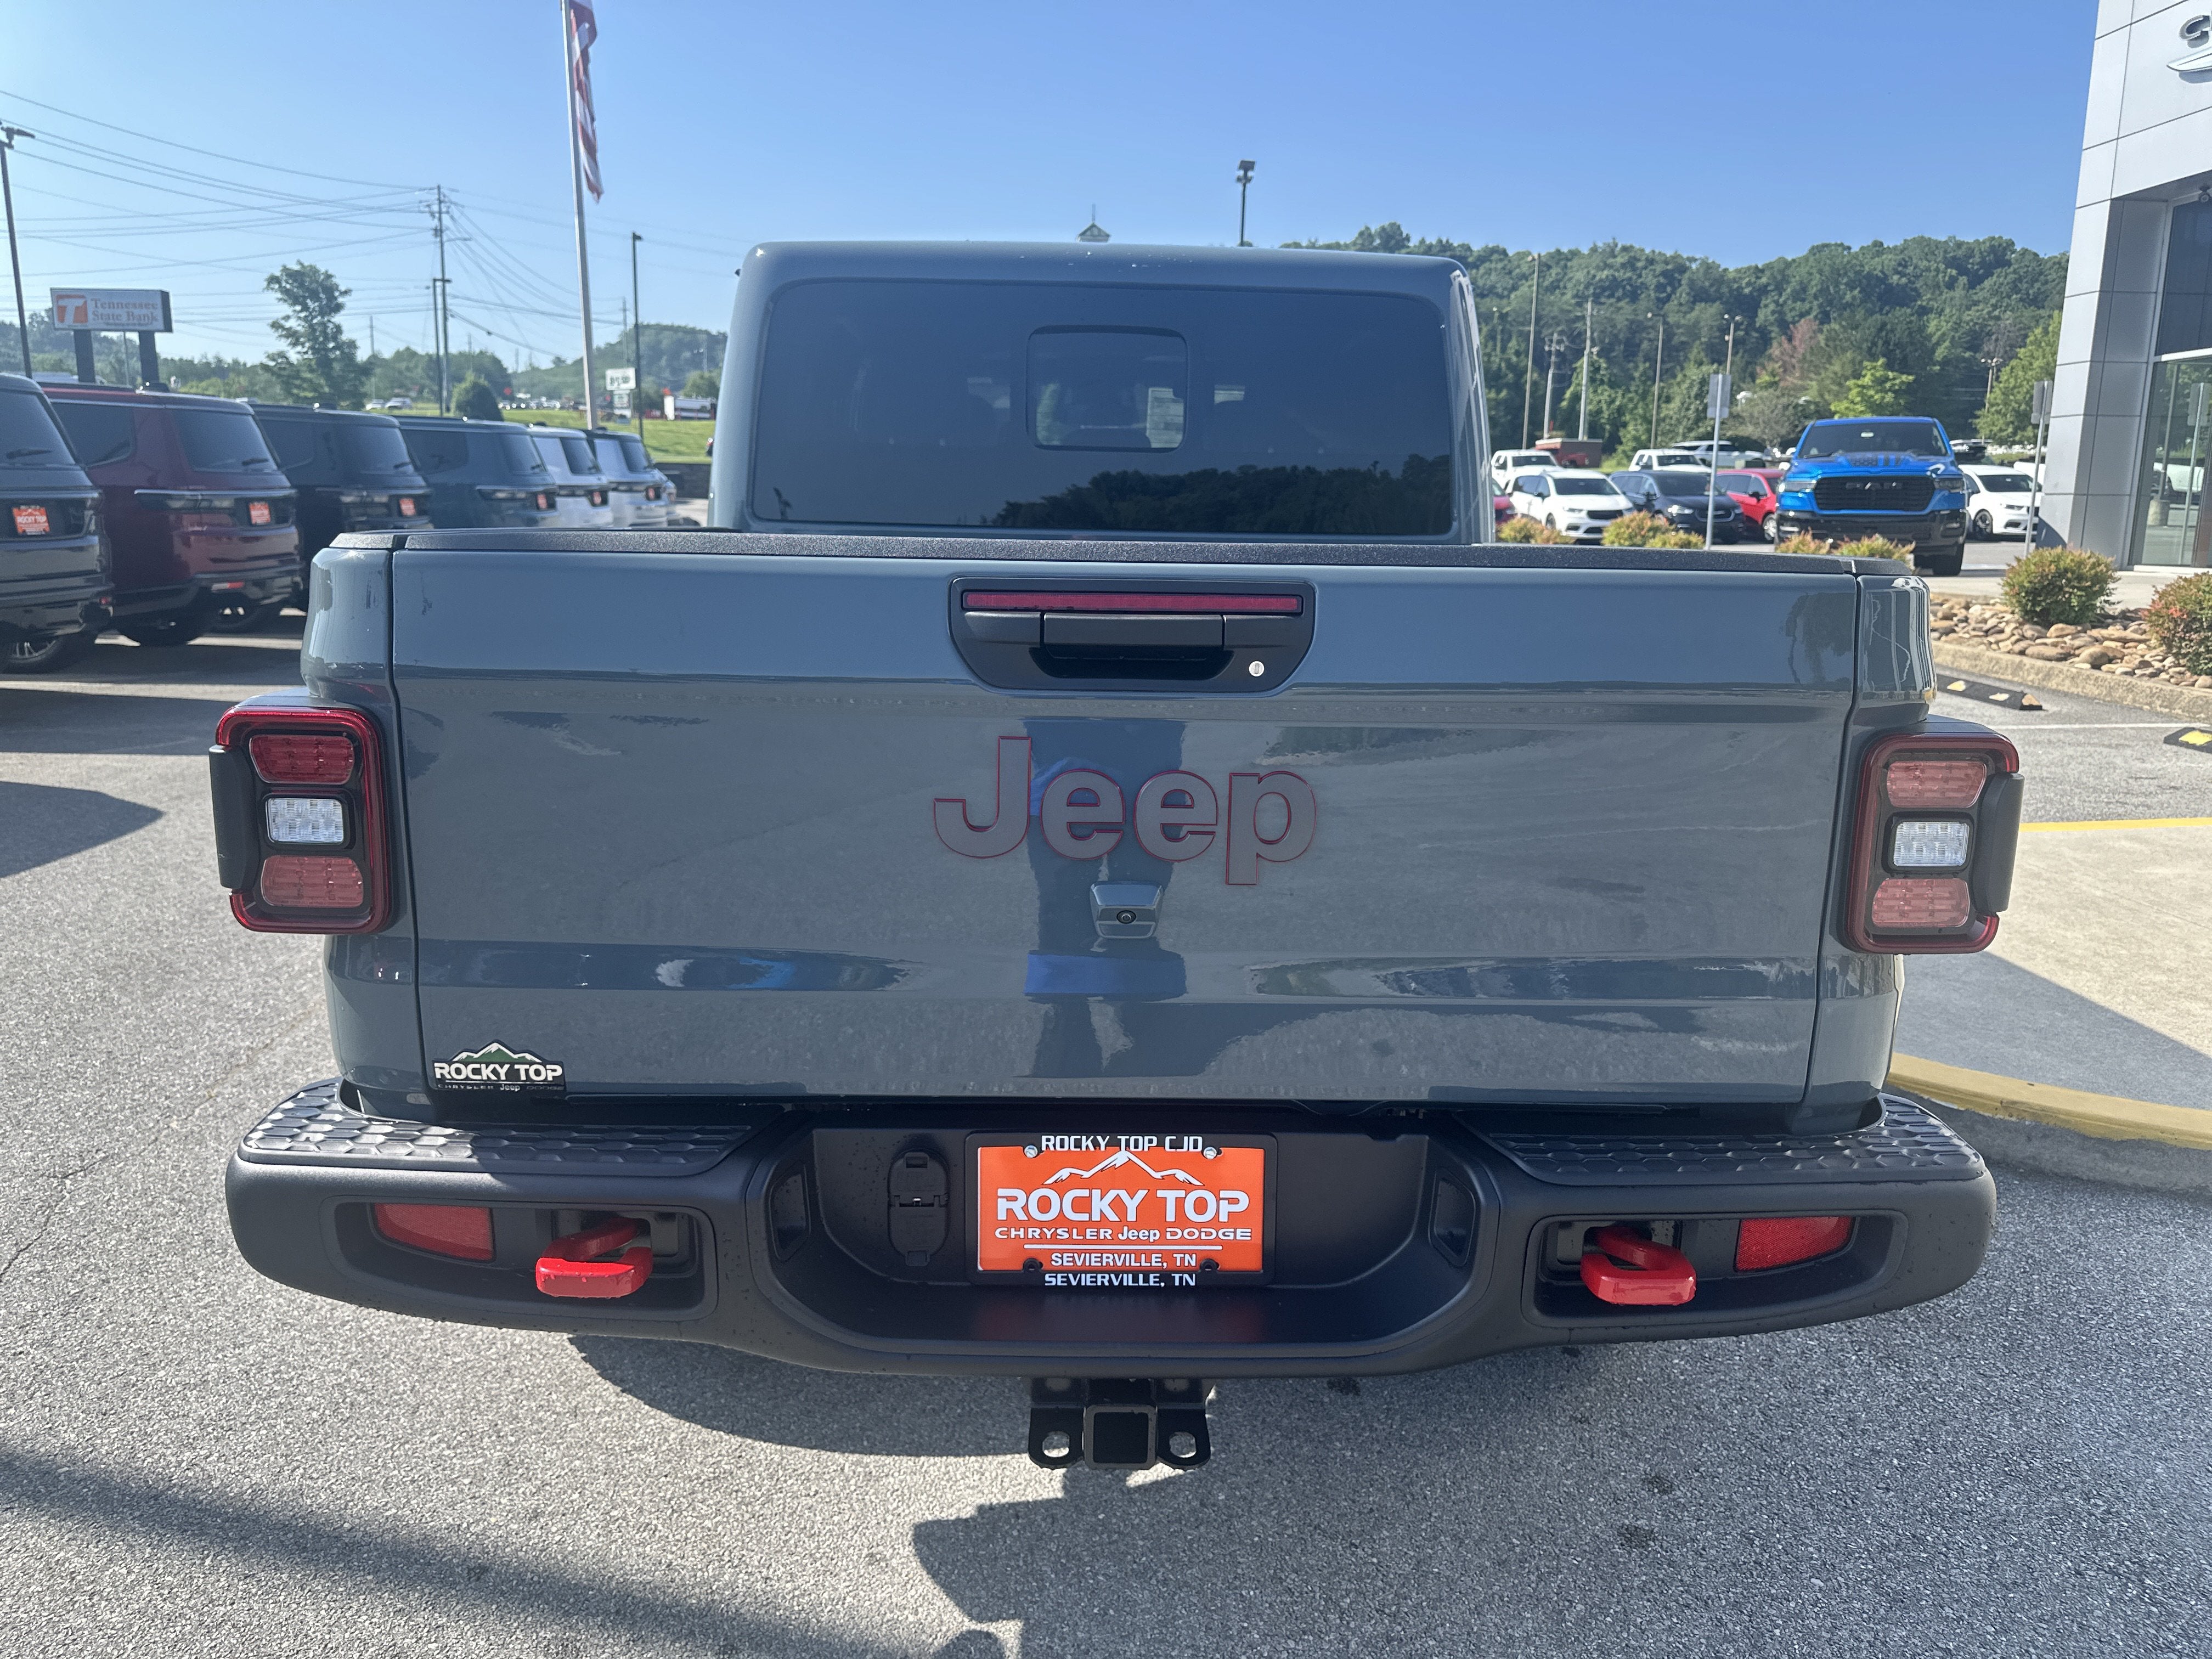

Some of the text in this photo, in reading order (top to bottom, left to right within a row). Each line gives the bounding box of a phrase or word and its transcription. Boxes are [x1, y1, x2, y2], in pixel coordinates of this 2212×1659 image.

[91, 298, 158, 309] Tennessee
[92, 310, 159, 323] State Bank
[933, 736, 1317, 885] Jeep
[434, 1062, 563, 1081] ROCKY TOP
[500, 1084, 521, 1092] Jeep
[1041, 1135, 1203, 1152] ROCKY TOP CJD
[995, 1188, 1250, 1223] ROCKY TOP
[995, 1226, 1252, 1243] CHRYSLER Jeep DODGE
[1051, 1253, 1197, 1269] SEVIERVILLE, TN
[1045, 1273, 1196, 1288] SEVIERVILLE, TN
